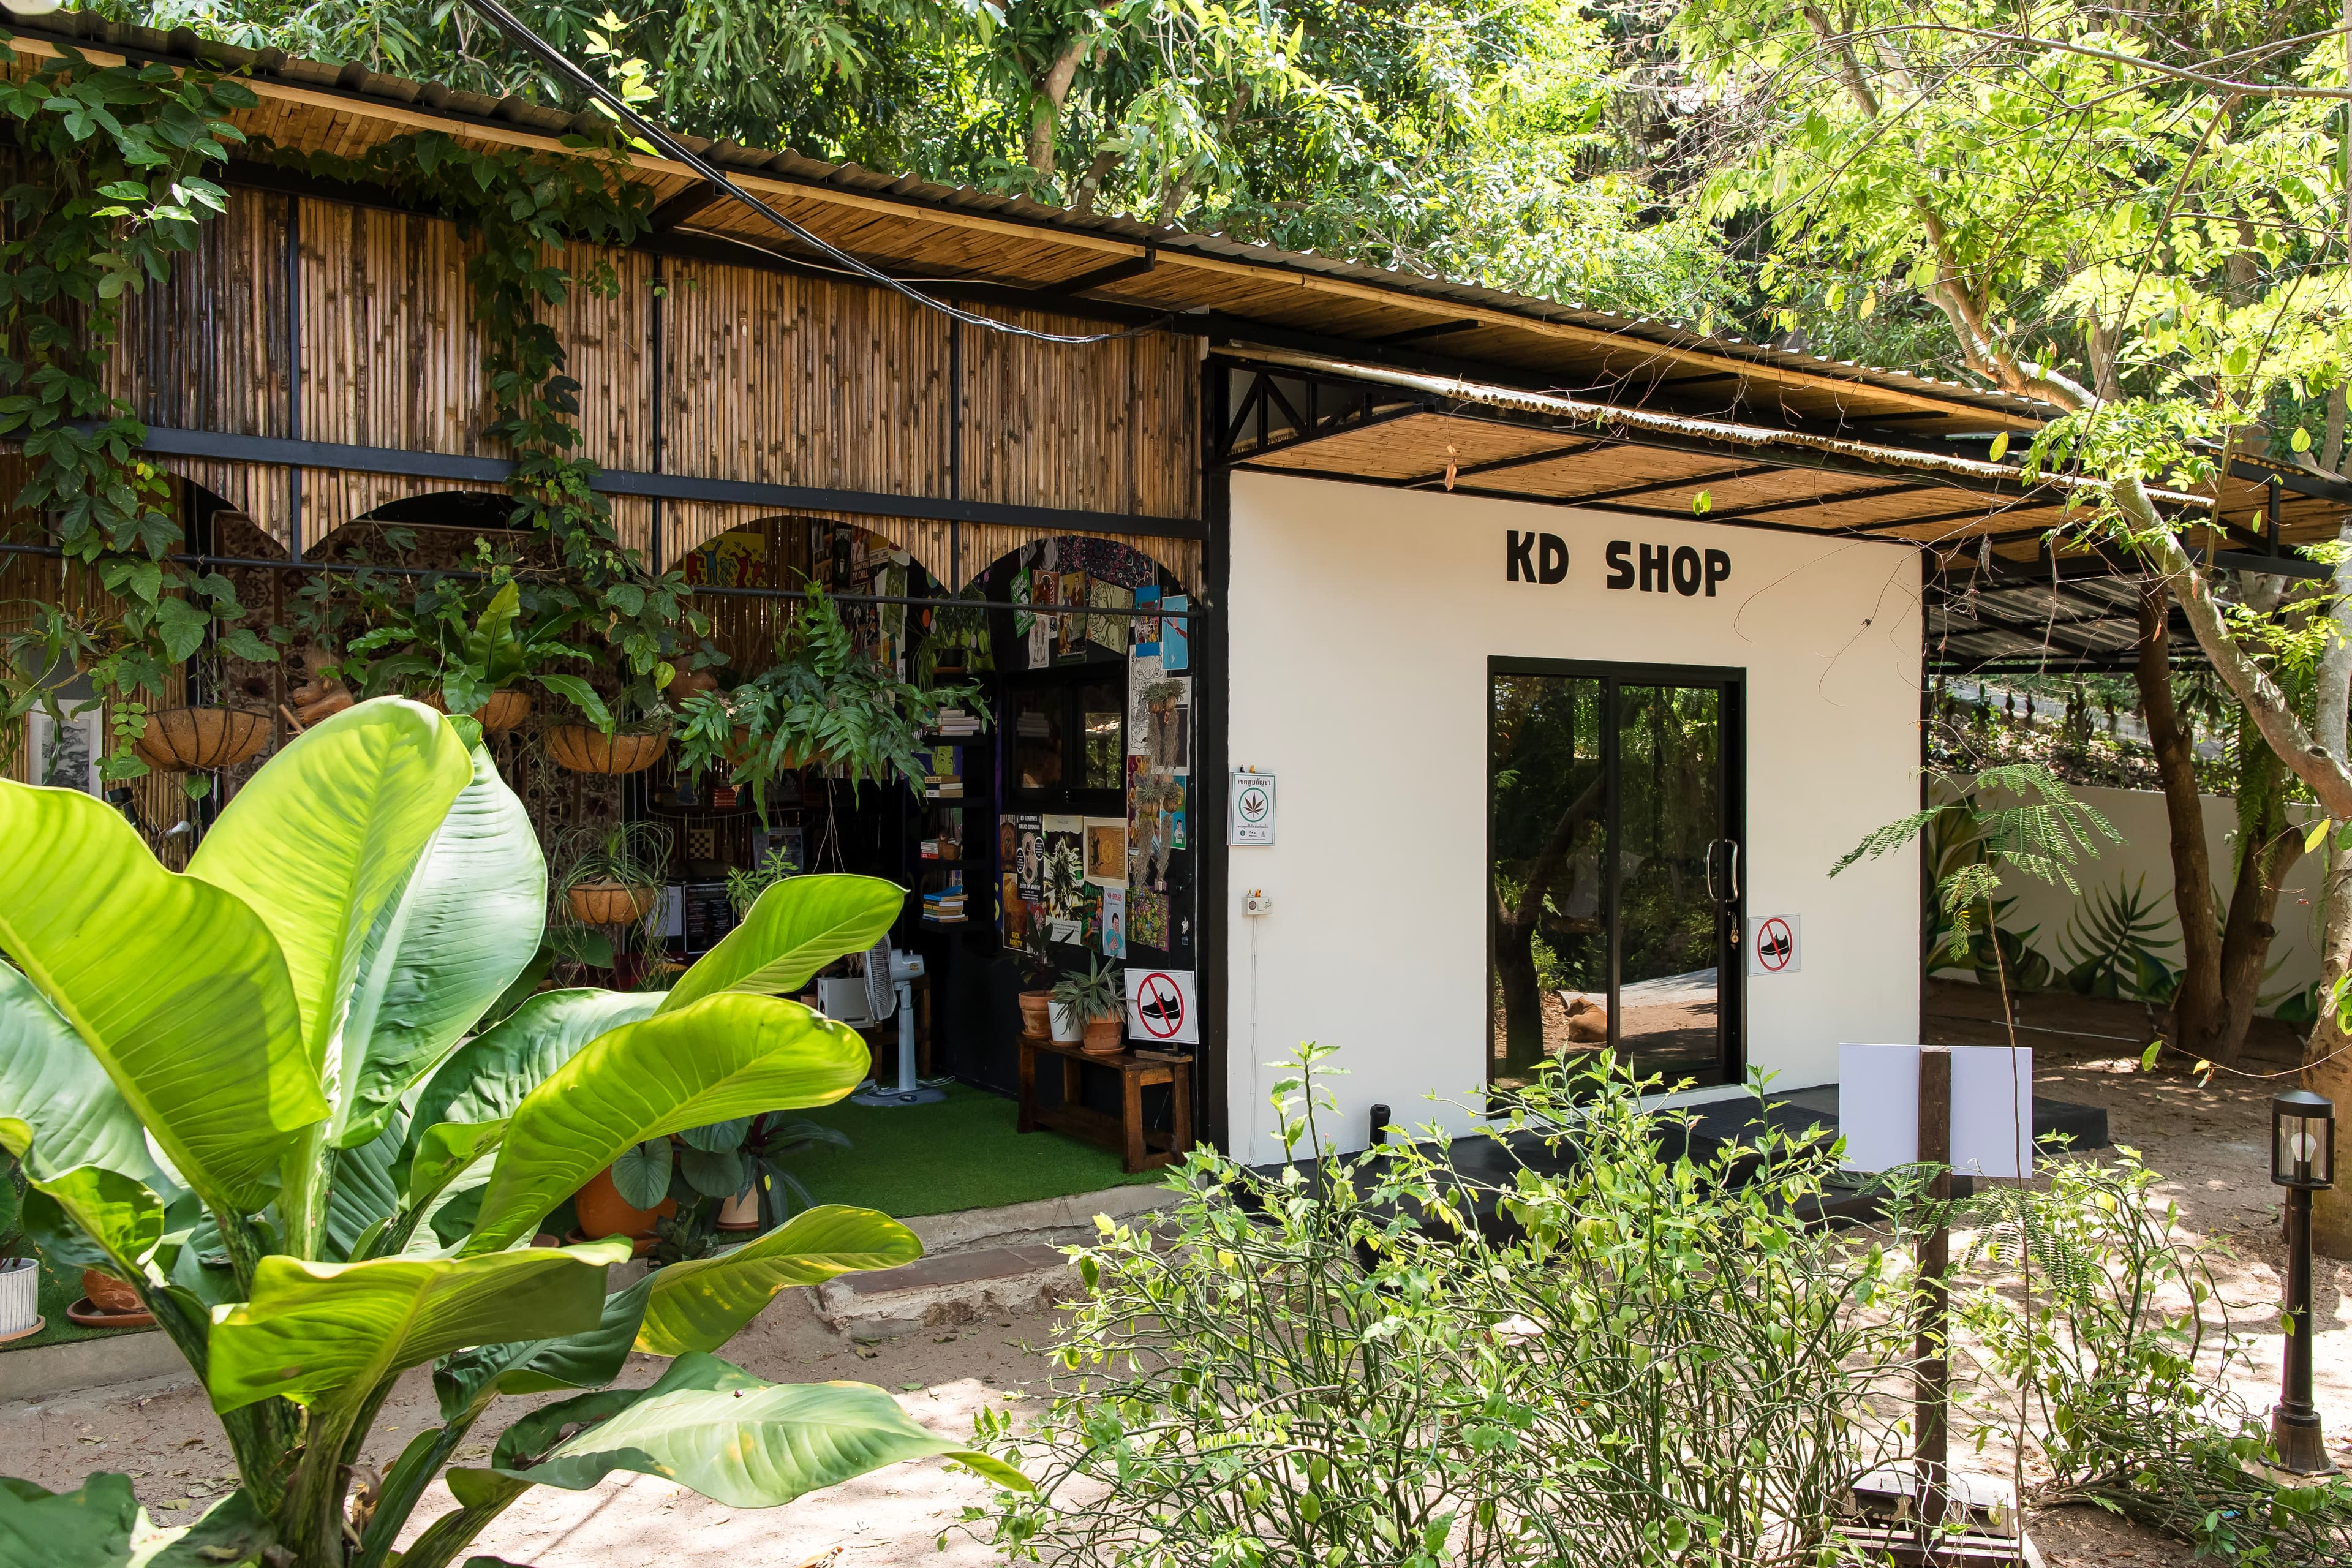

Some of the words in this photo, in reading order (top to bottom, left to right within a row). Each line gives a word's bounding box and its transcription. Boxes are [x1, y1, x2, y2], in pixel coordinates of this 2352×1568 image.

[1506, 530, 1569, 584] KD
[1606, 540, 1731, 597] SHOP
[853, 571, 858, 581] TO
[858, 568, 869, 579] CHILL
[1112, 893, 1122, 902] DRUGS
